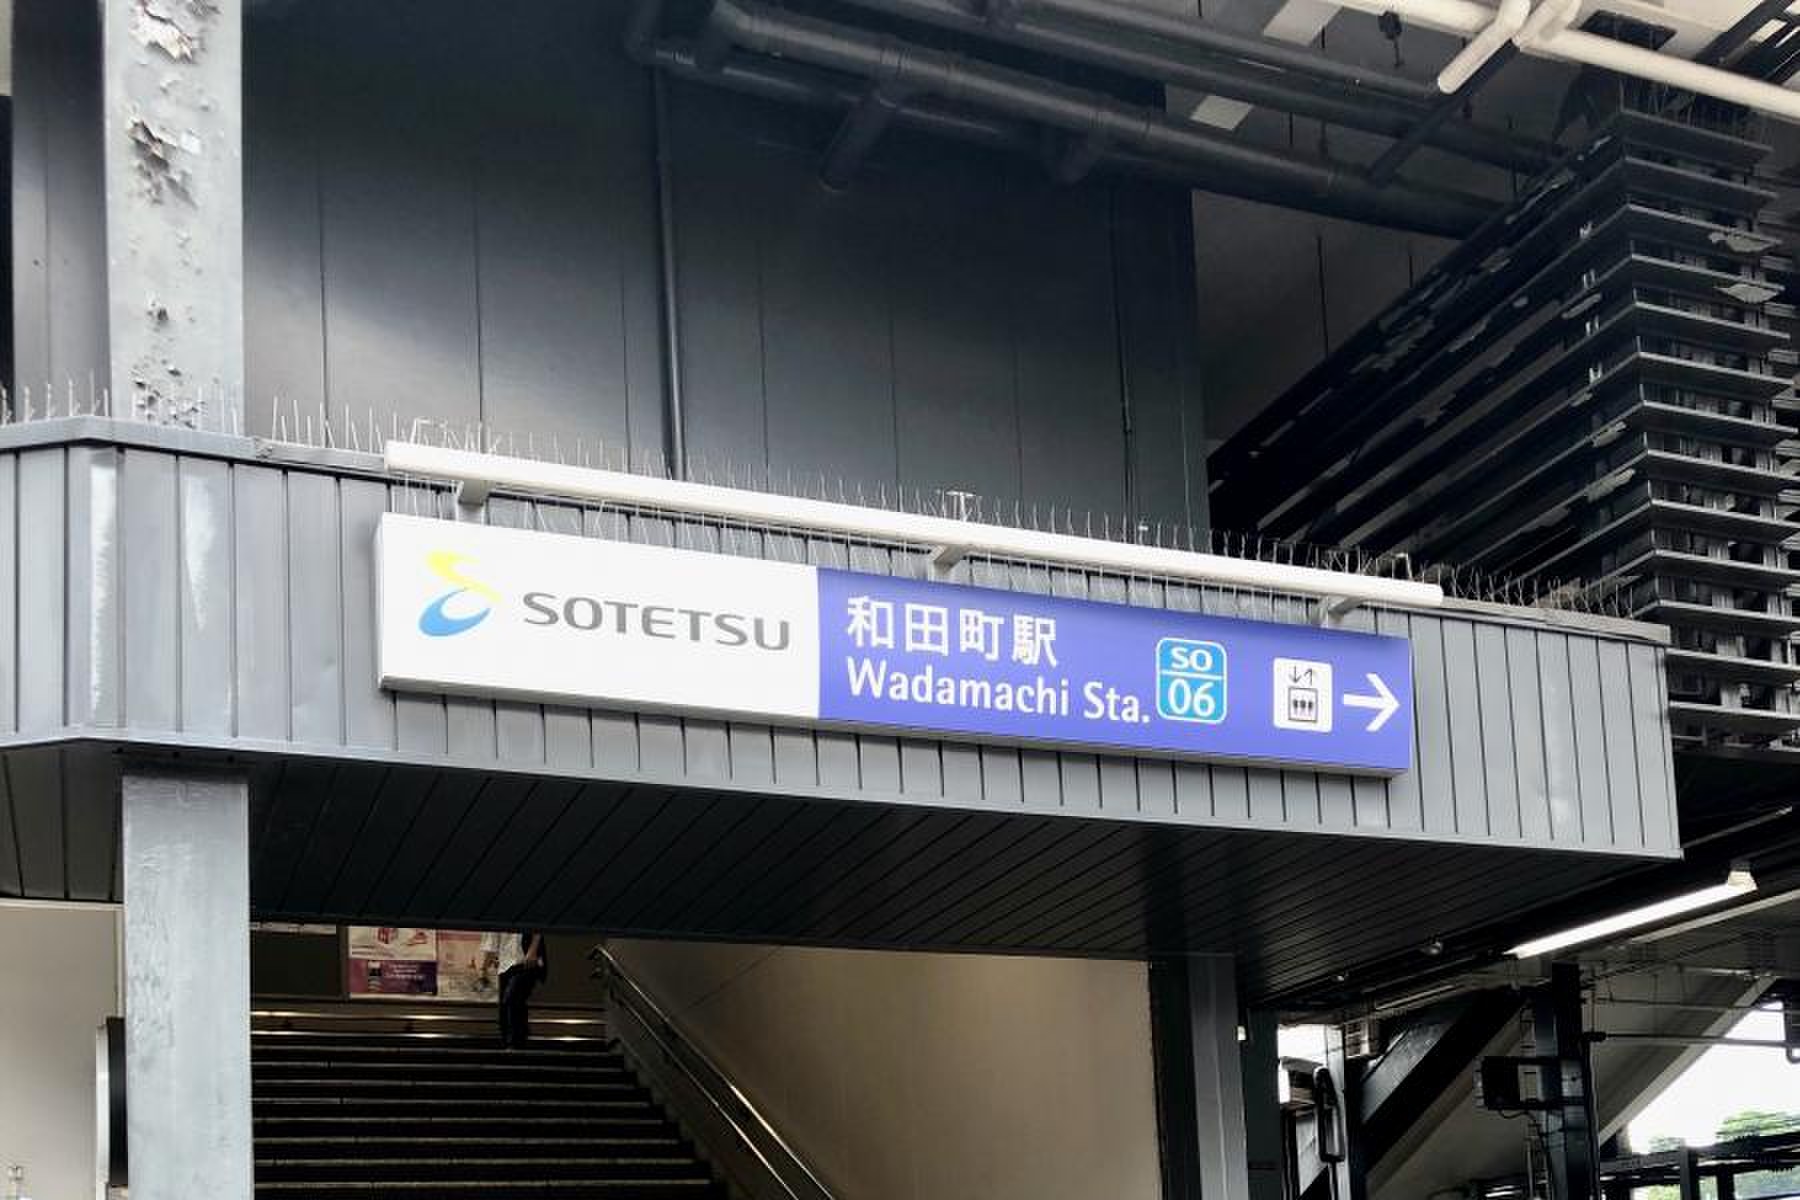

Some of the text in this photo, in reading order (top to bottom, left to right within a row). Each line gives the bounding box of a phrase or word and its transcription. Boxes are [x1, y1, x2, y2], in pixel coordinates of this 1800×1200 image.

[522, 591, 790, 651] SOTETSU
[846, 596, 1059, 668] 和田町駅
[1170, 645, 1213, 673] SO
[846, 656, 1151, 725] Wadamachi Sta.
[1166, 678, 1216, 718] 06
